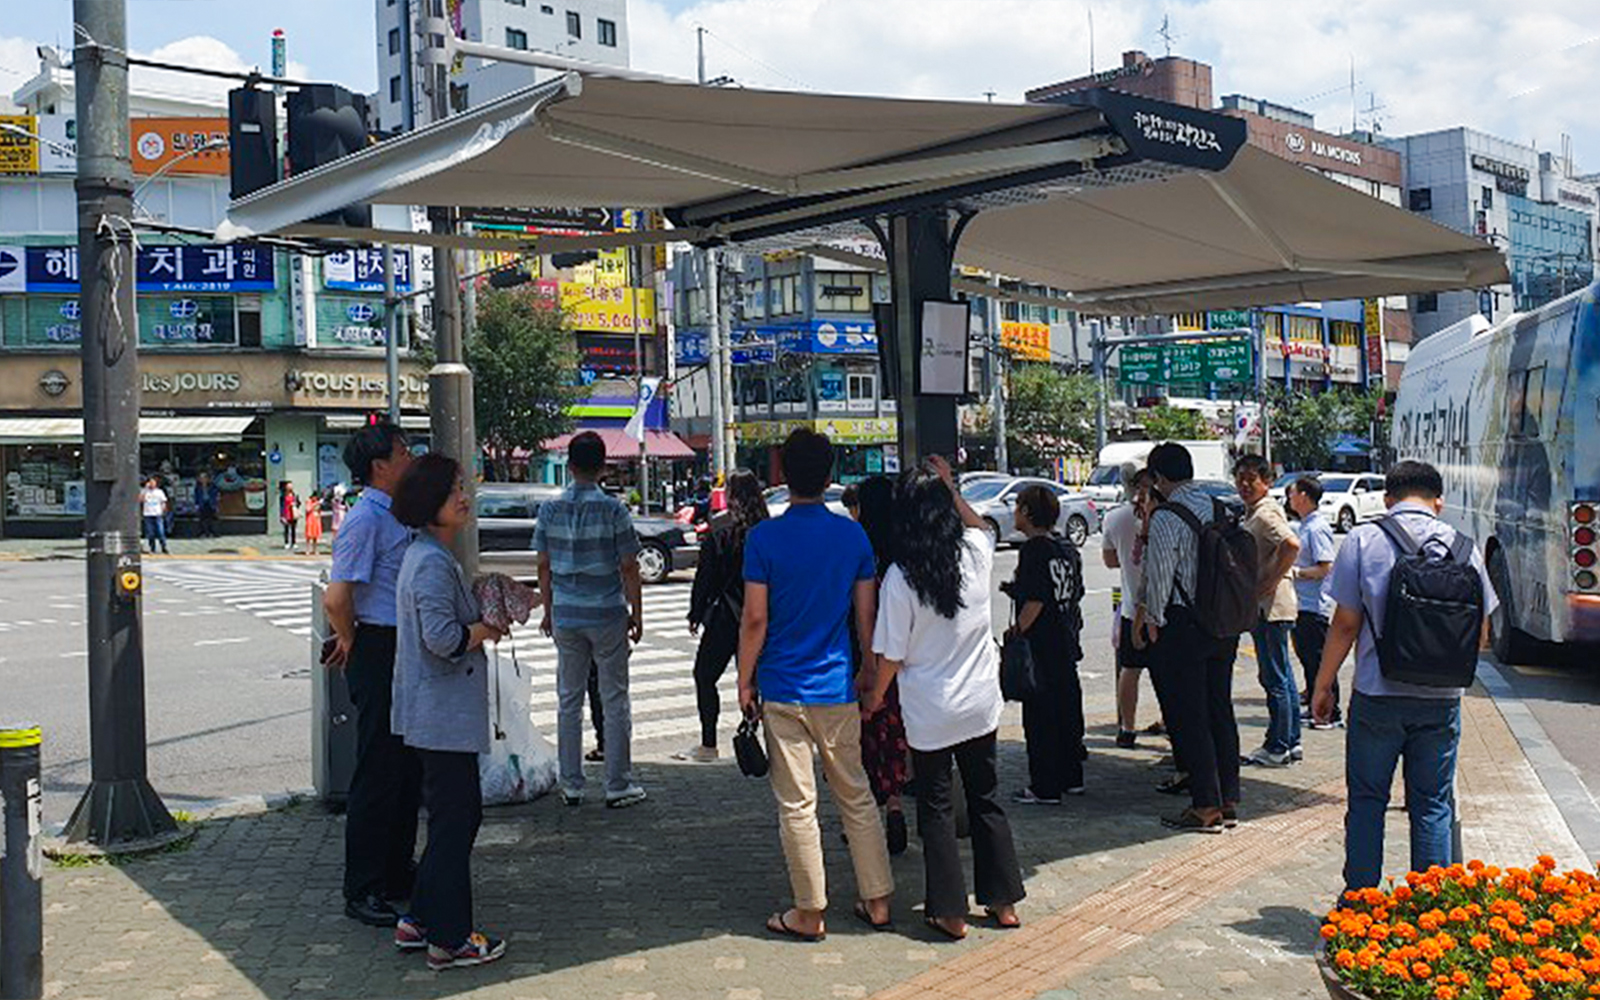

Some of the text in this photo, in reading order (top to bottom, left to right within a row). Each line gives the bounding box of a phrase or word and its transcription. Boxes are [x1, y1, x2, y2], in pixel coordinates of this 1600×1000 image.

[141, 373, 240, 394] les JOURS
[302, 372, 355, 393] TOUS
[359, 373, 386, 393] les
